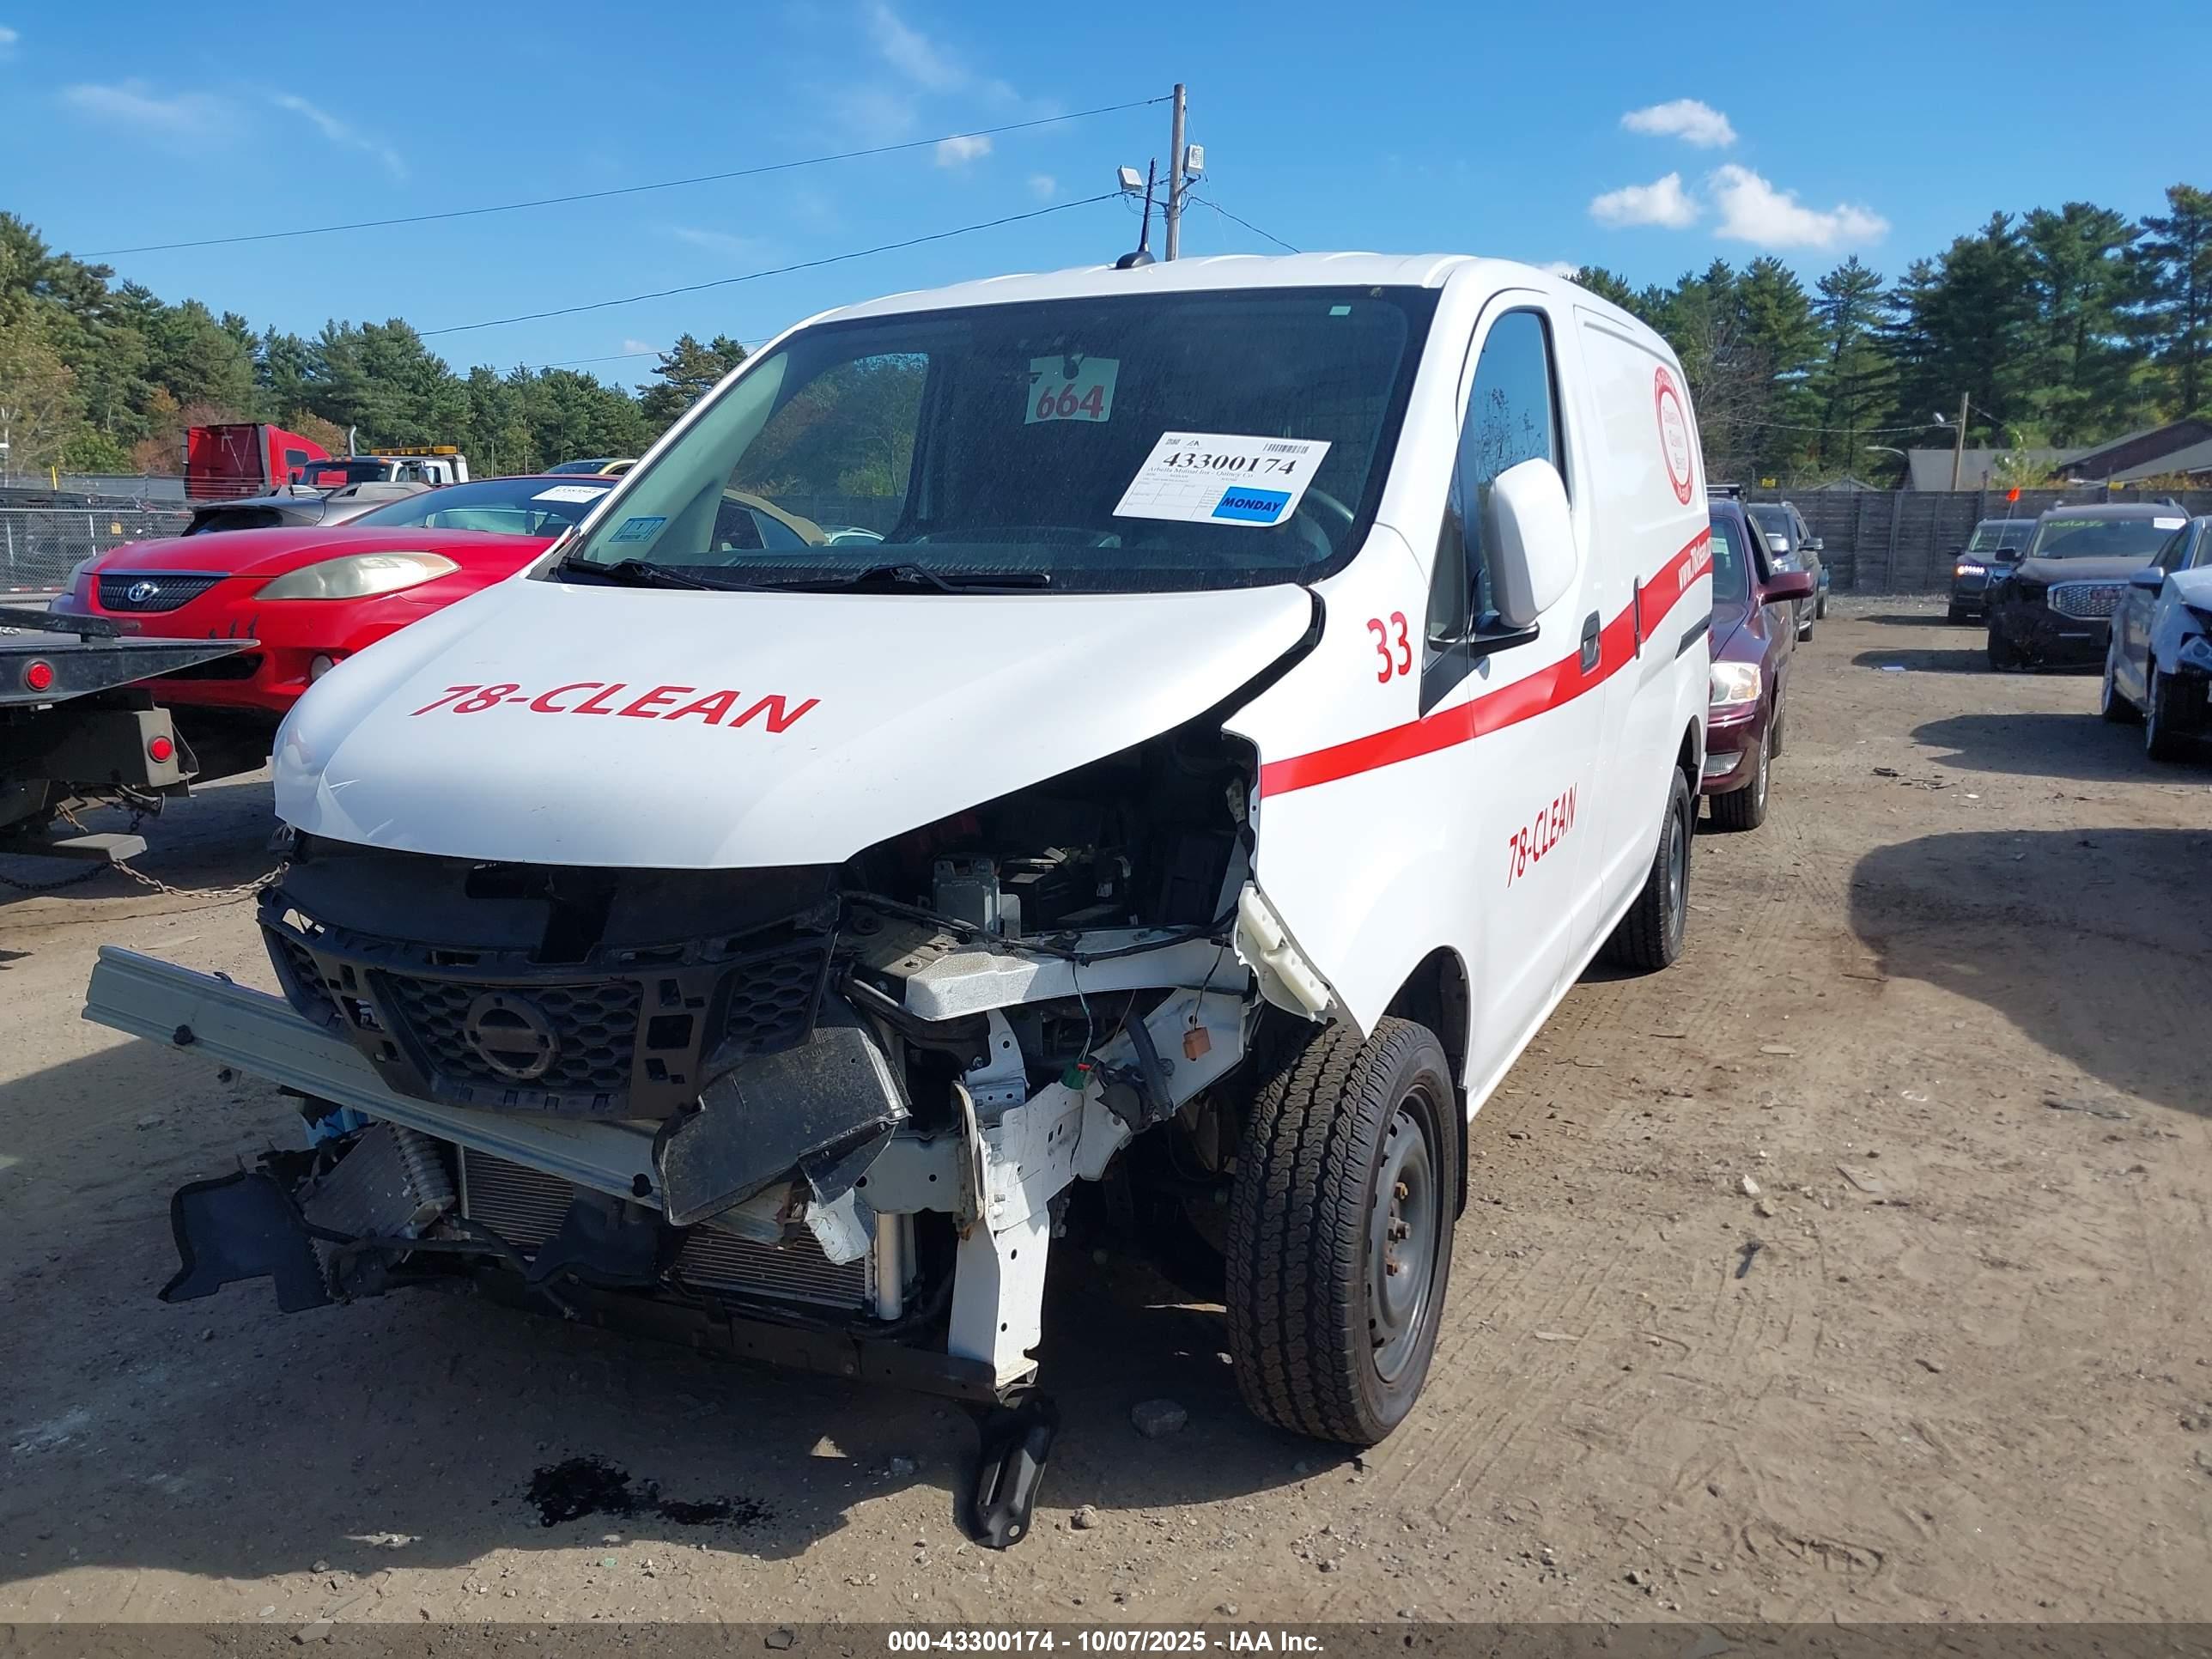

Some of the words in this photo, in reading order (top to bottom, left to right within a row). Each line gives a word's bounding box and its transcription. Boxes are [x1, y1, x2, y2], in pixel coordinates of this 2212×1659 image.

[1036, 383, 1104, 419] 664
[1163, 452, 1297, 474] 43300174
[1221, 496, 1282, 512] MONDAY
[1367, 611, 1412, 684] 33
[408, 682, 821, 734] 78-CLEAN
[1507, 781, 1577, 889] 78-CLEAN
